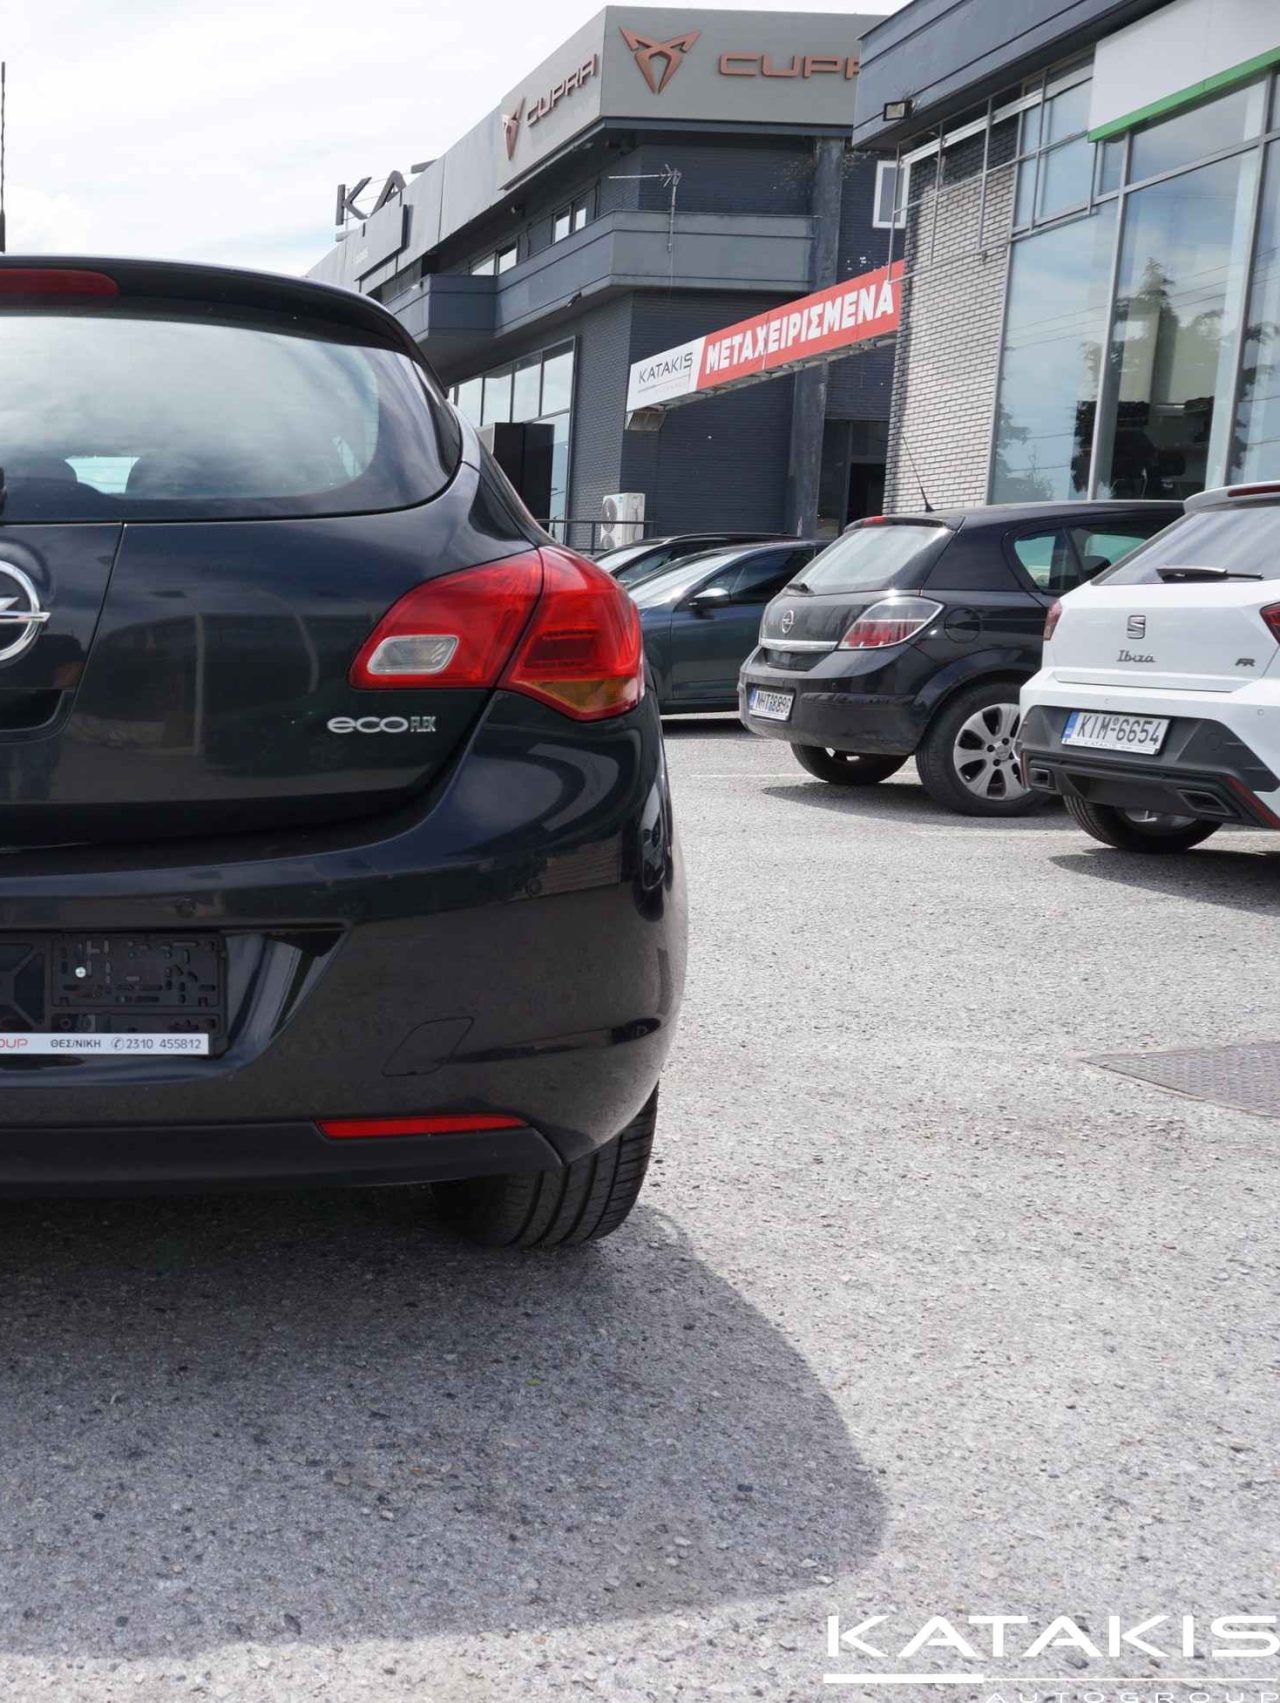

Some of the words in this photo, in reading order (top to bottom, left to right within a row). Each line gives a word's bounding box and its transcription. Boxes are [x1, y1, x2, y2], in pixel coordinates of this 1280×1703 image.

[527, 53, 597, 127] CUPRA
[705, 280, 894, 375] ΜΕΤΑΧΕΙΡΙΣΜΕΝΑ
[638, 351, 694, 384] KATAKIS
[1117, 650, 1156, 663] Ibiza
[50, 1039, 101, 1049] ΘΕΣ/ΝΙΚΗ
[126, 1038, 154, 1050] 2310
[159, 1038, 202, 1050] 455812
